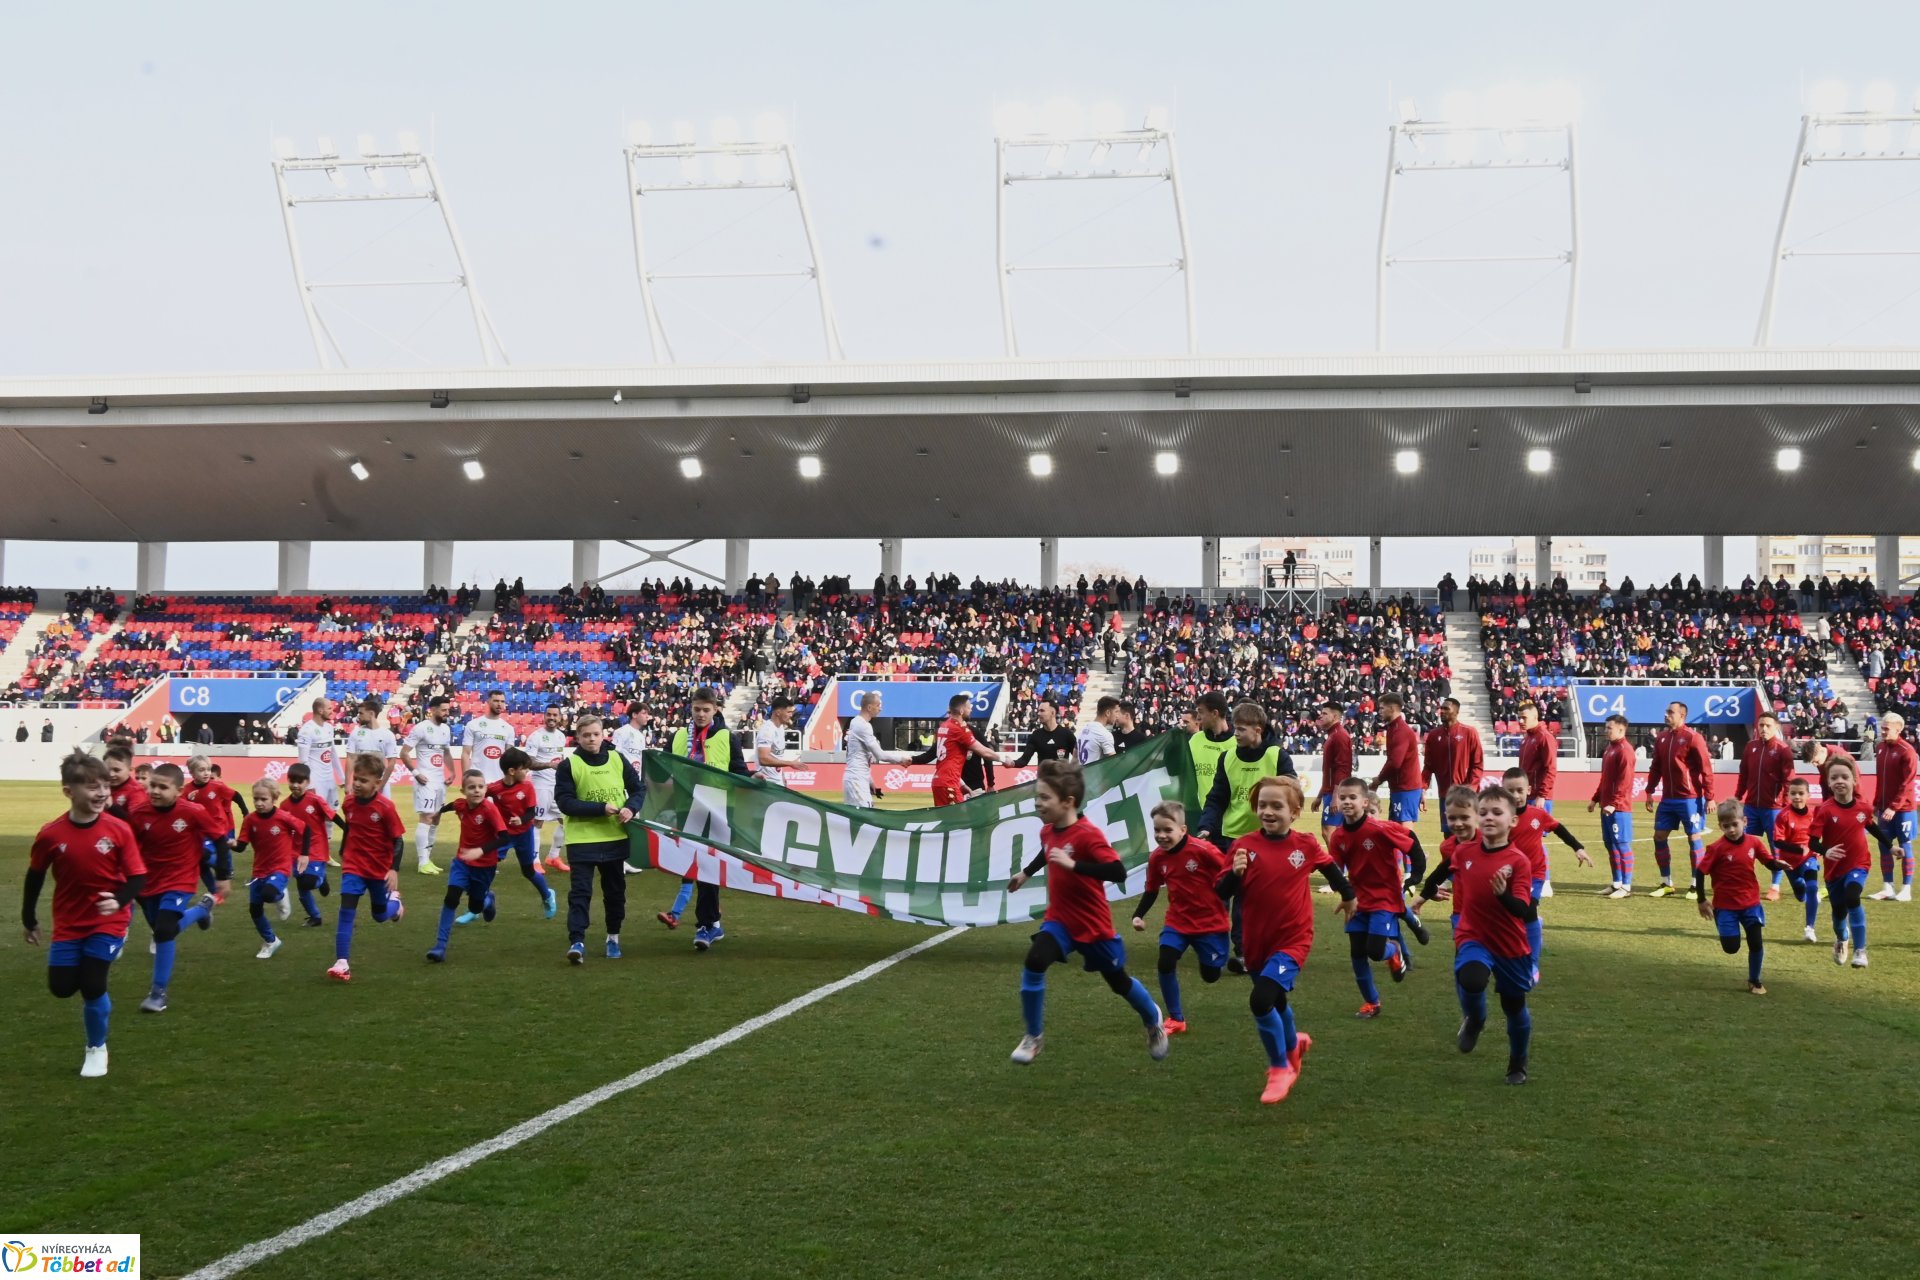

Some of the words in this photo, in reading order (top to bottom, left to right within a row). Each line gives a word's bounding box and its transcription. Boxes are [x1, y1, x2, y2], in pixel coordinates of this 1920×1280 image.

[180, 686, 210, 706] C8
[850, 689, 883, 711] C
[1588, 694, 1627, 716] C4
[1704, 695, 1741, 717] C3
[1078, 738, 1089, 765] 16
[423, 798, 434, 809] 77
[1393, 802, 1402, 812] 24
[682, 783, 732, 847] A
[760, 766, 1173, 883] GYŰLÖET
